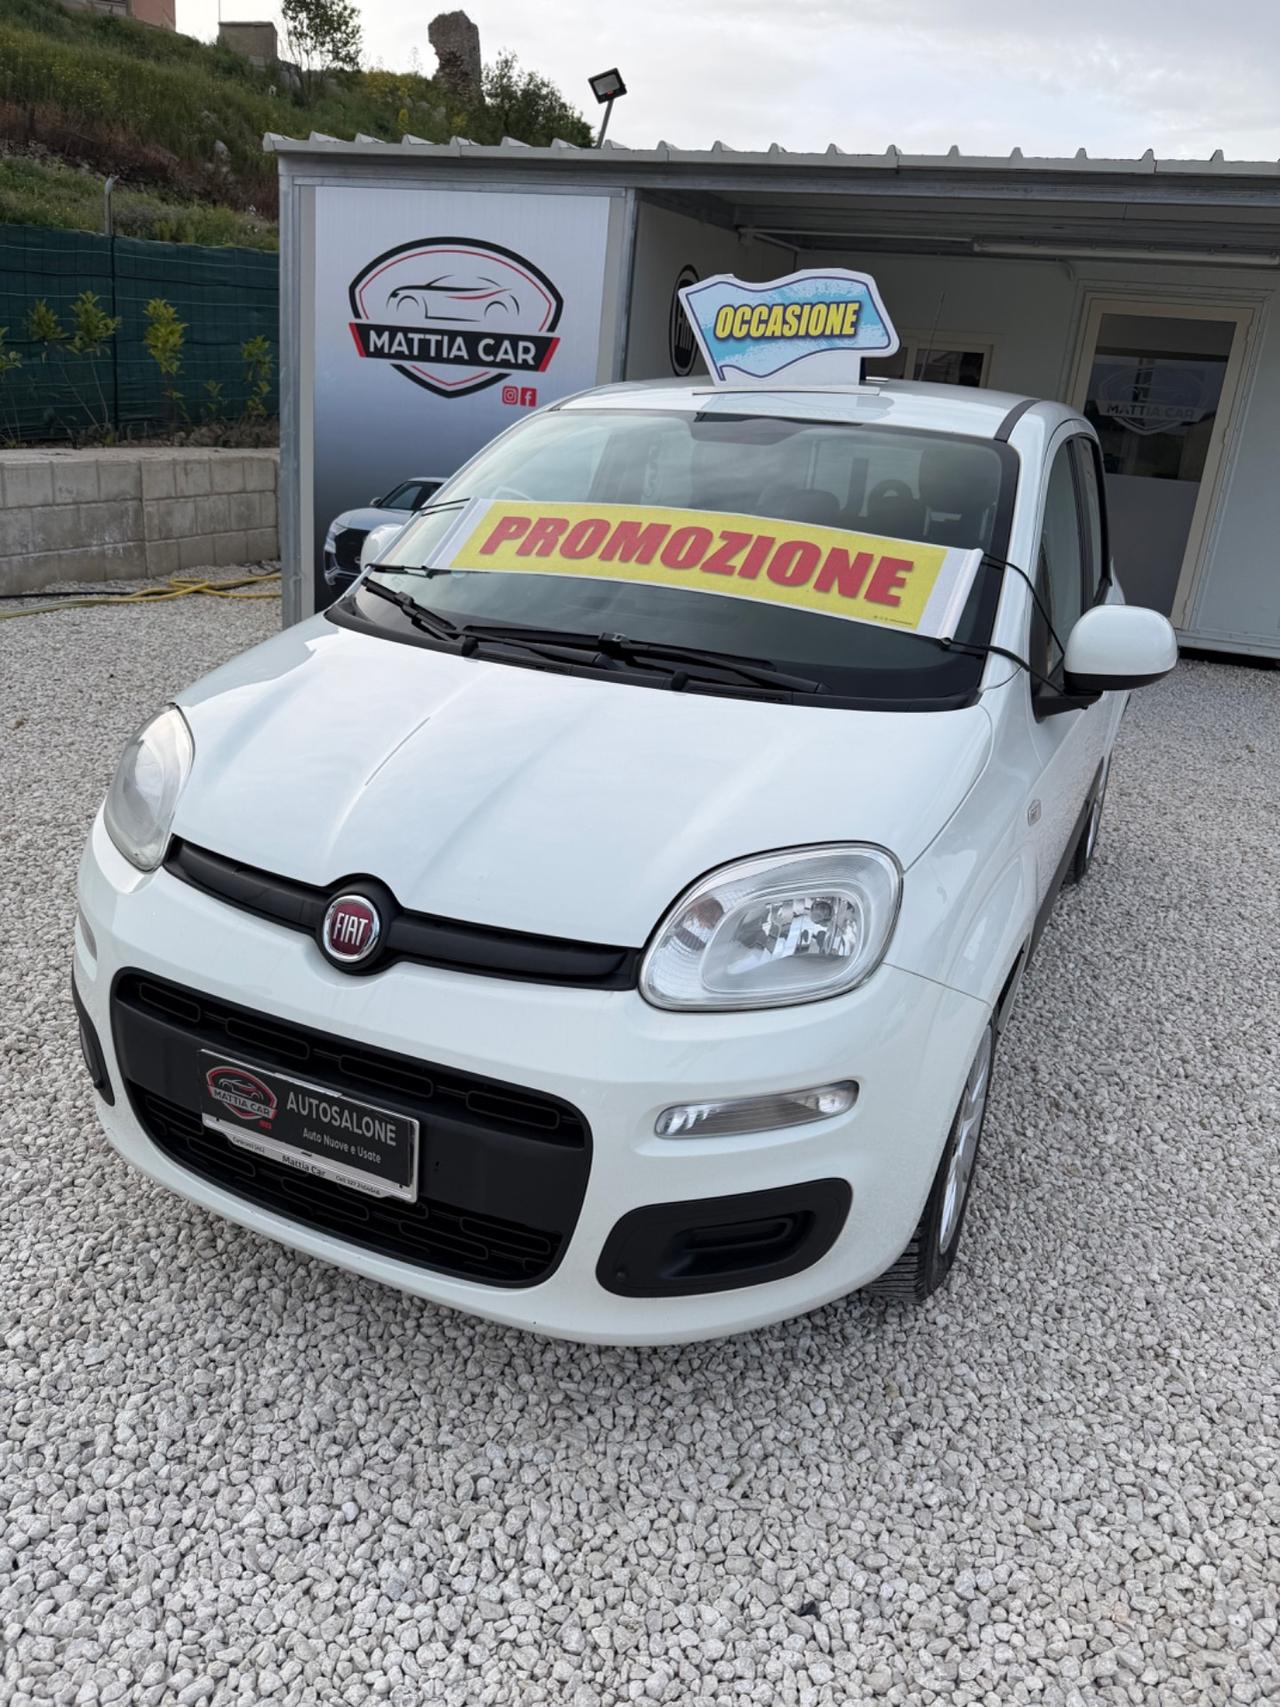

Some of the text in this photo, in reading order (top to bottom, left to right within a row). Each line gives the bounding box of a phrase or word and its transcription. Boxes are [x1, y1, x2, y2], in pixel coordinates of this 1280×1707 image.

[714, 301, 861, 339] OCCASIONE
[368, 330, 536, 366] MATTIA CAR
[1106, 402, 1195, 420] MATTIA CAR
[478, 514, 915, 608] PROMOZIONE
[332, 912, 369, 946] FIAT
[212, 1089, 272, 1117] MATTIA CAR
[286, 1091, 398, 1147] AUTOSALONE
[302, 1127, 382, 1165] Auto Nuove e Usate
[282, 1154, 327, 1177] Mattia Car
